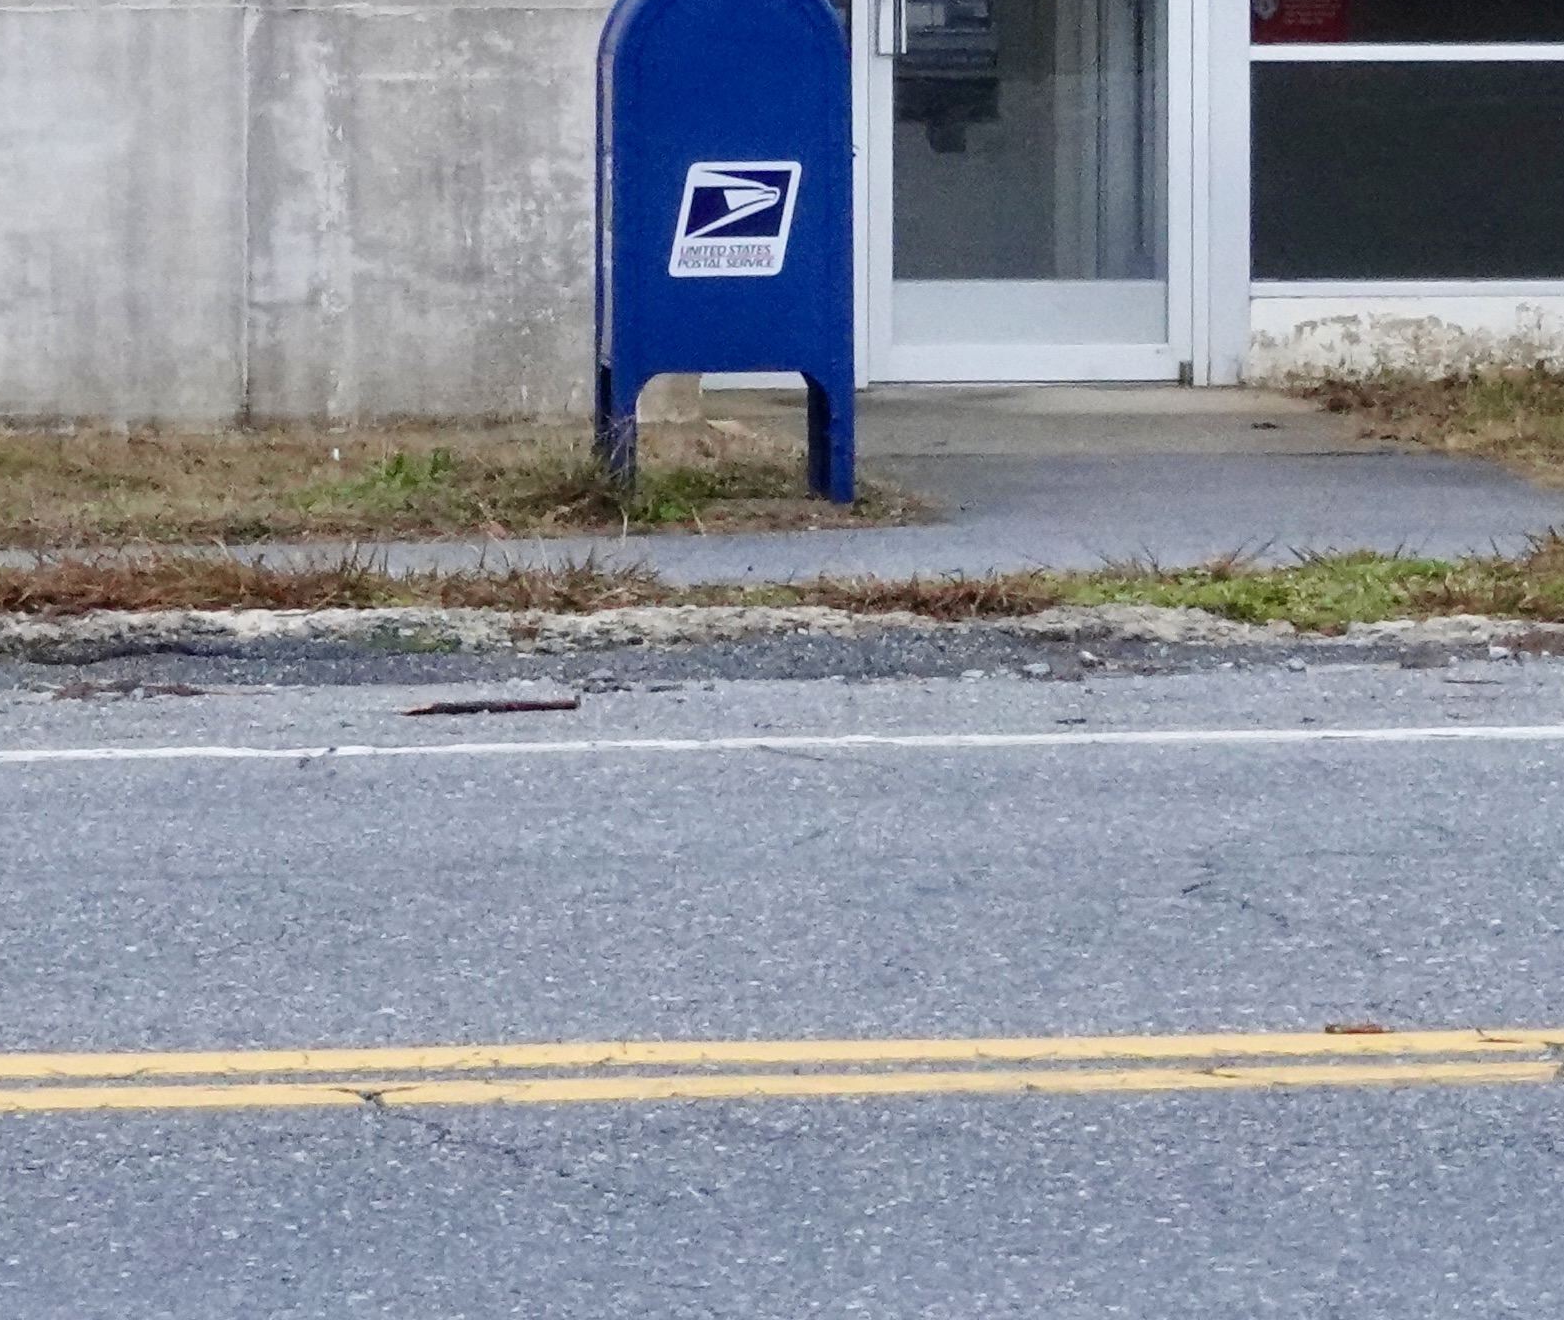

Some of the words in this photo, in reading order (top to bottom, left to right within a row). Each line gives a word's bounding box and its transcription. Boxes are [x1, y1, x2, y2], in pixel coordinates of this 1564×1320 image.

[680, 245, 726, 256] UNITED
[729, 245, 771, 255] STATES
[677, 258, 722, 269] POSTAL
[726, 257, 774, 268] SERVICE
